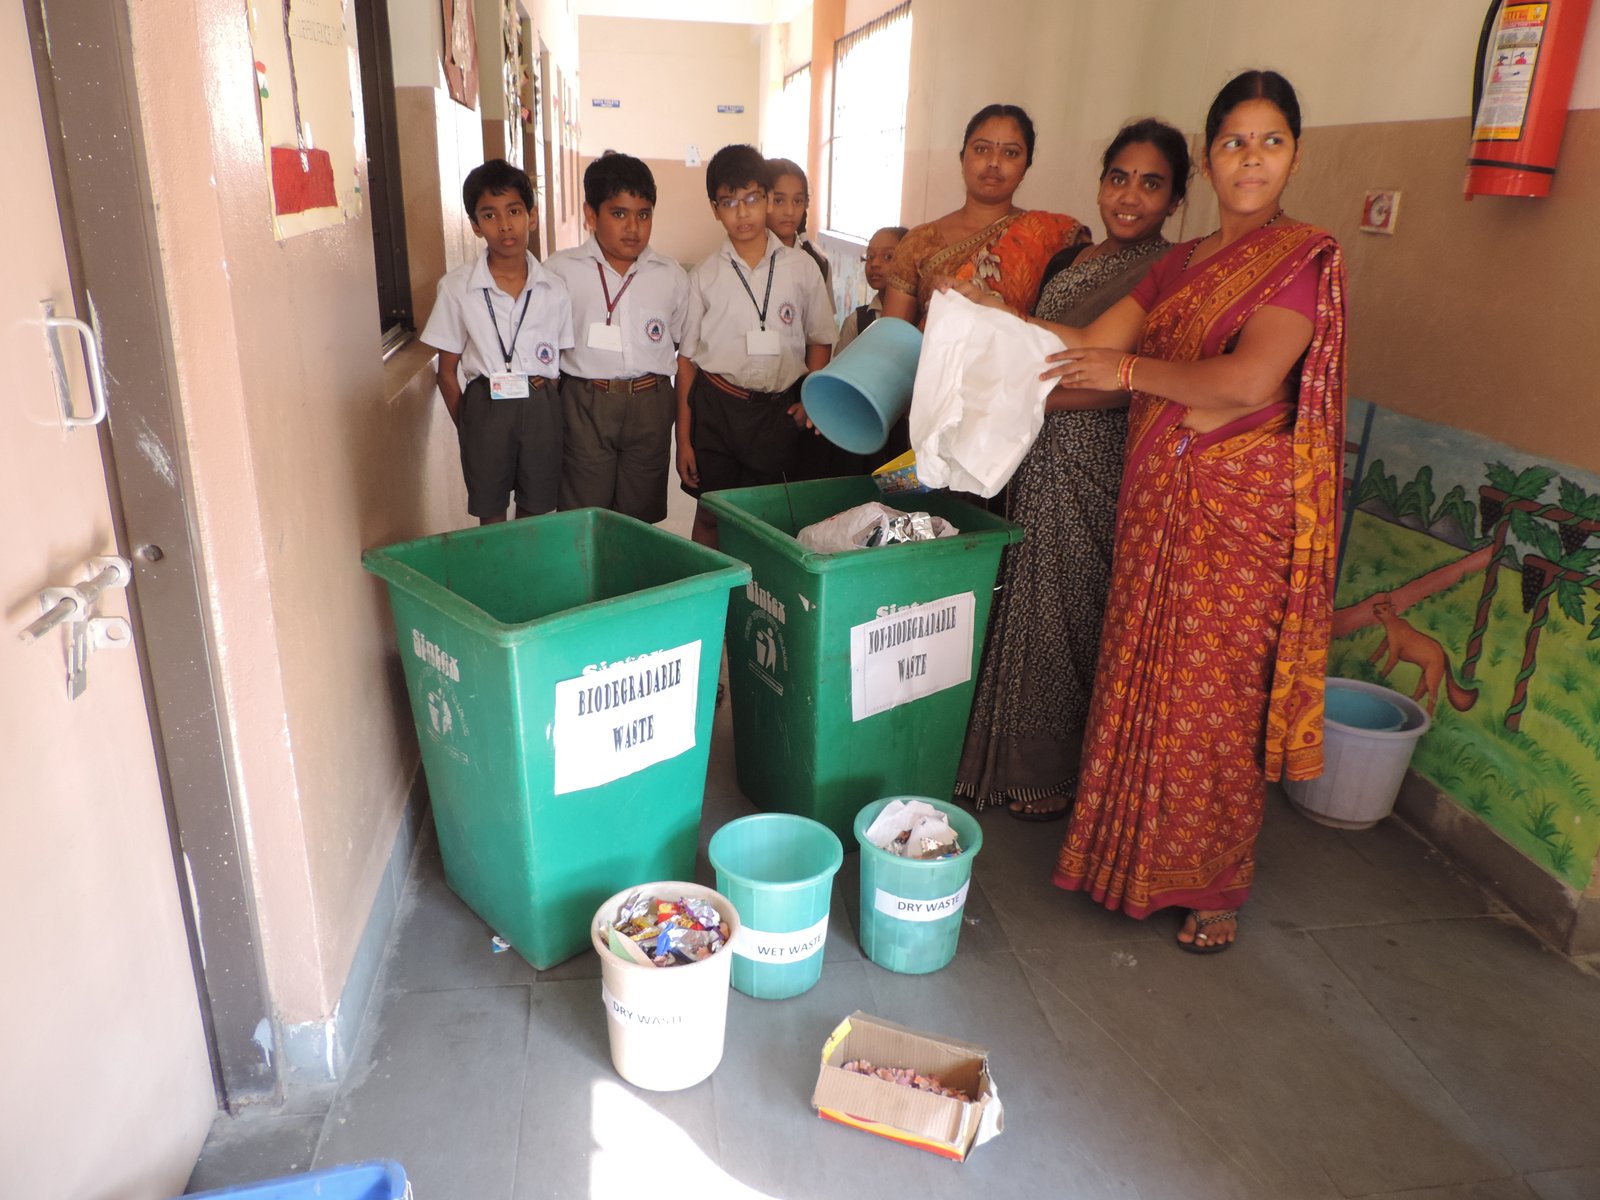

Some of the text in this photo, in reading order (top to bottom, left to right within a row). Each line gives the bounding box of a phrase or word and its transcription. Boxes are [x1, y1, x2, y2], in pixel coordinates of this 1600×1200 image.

[868, 605, 957, 655] NON-BIODEGRADABLE
[412, 628, 460, 683] Sintex
[897, 653, 928, 683] WASTE
[578, 658, 682, 717] BIODEGRADABLE
[612, 714, 655, 752] WASTE
[897, 894, 960, 912] DRY WASTE
[757, 933, 822, 956] WET WASTE
[613, 1000, 633, 1019] DRY
